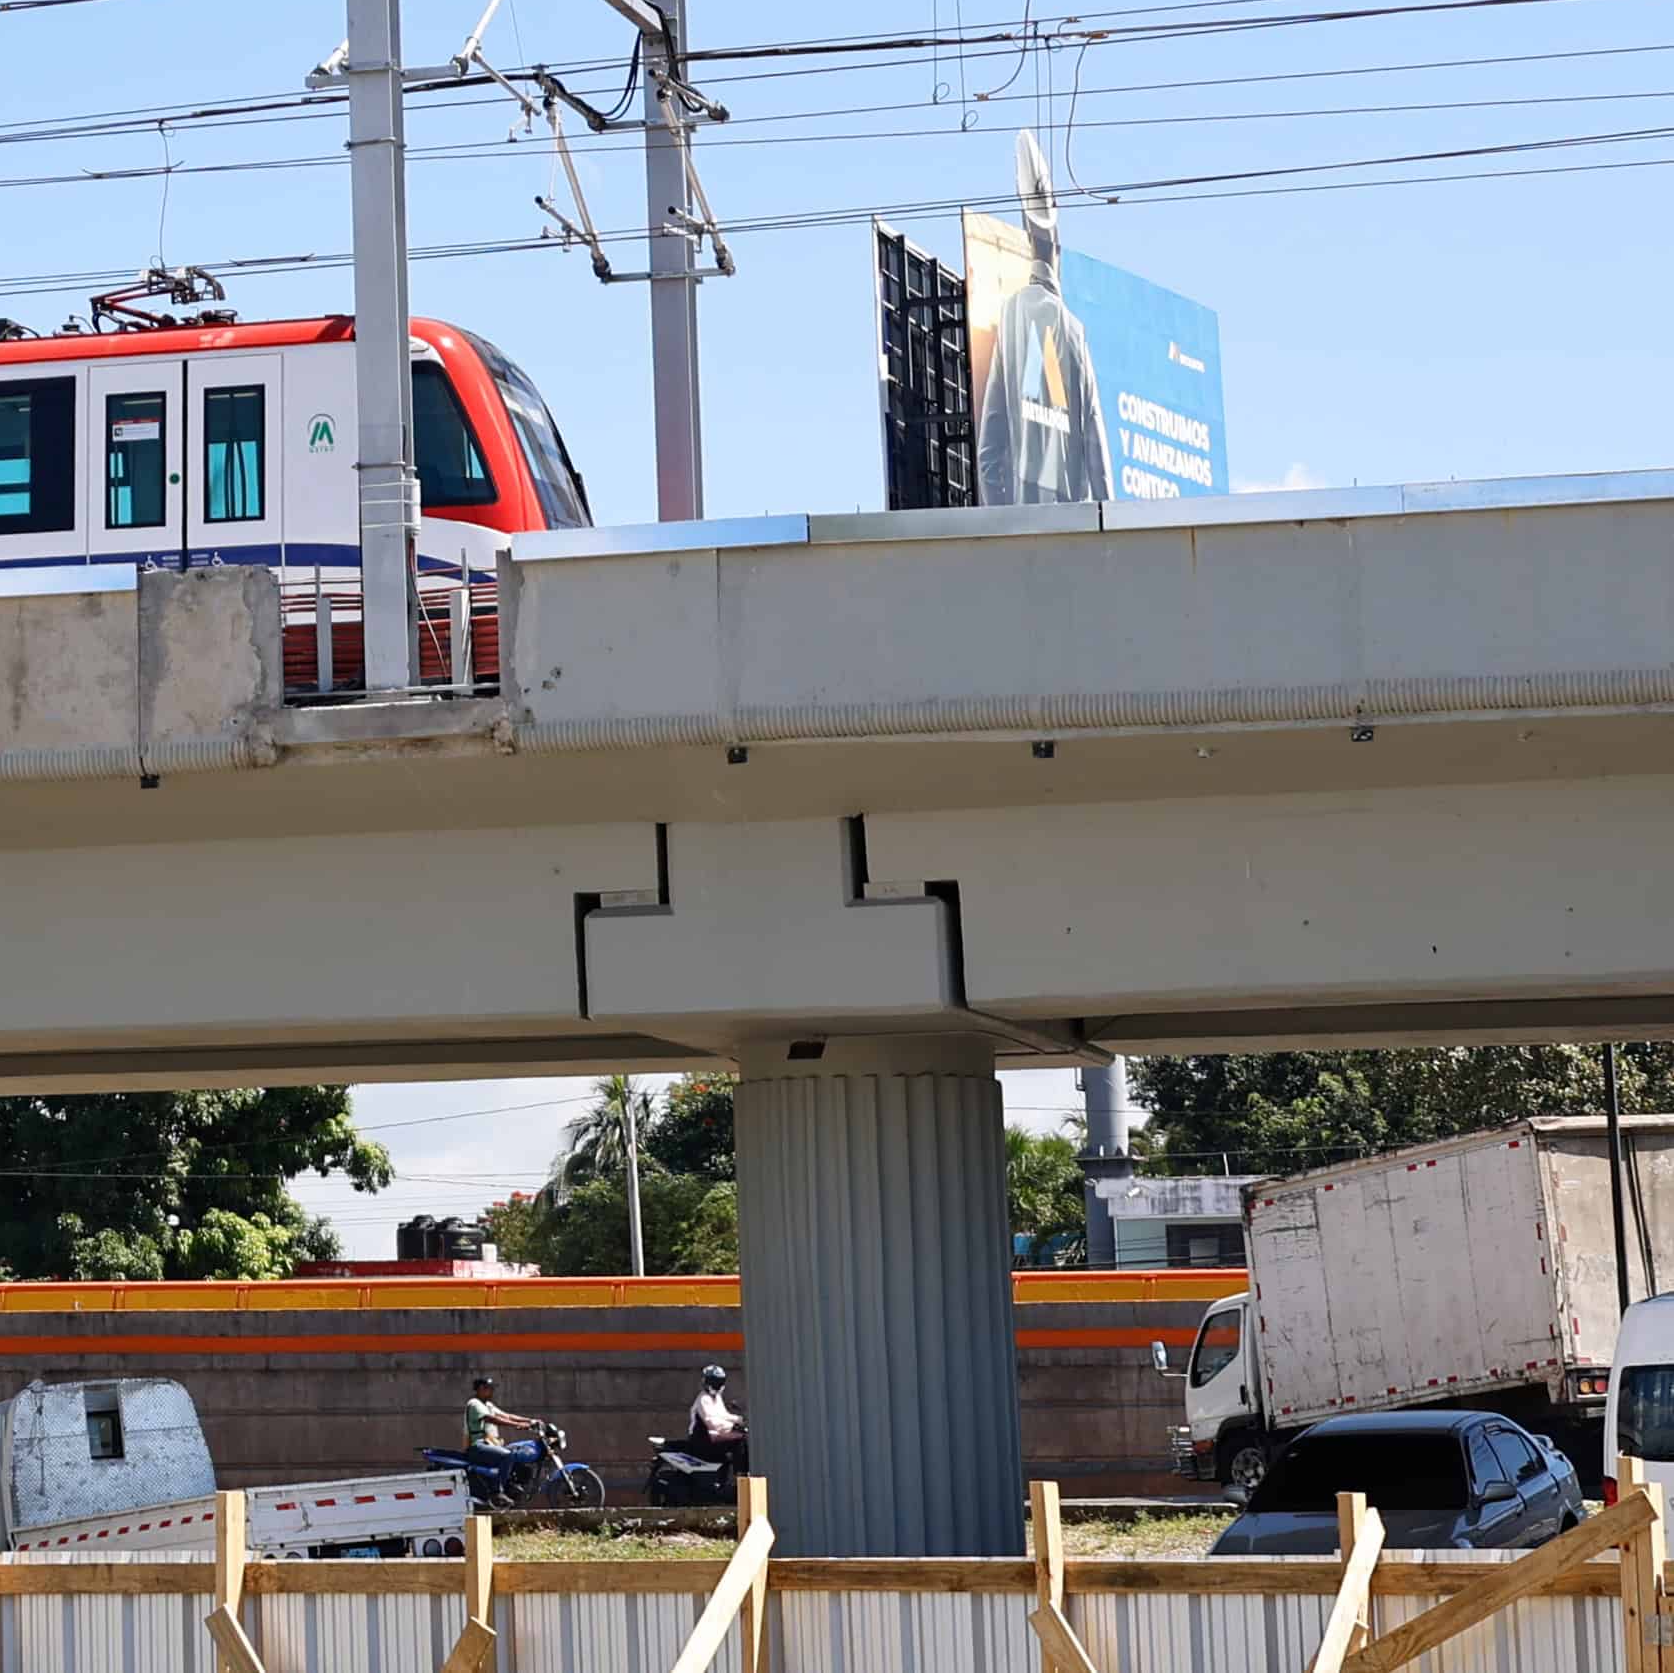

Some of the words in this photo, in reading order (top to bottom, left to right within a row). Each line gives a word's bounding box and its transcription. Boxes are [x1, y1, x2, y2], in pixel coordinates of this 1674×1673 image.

[1118, 392, 1210, 452] CONSTRUIMOS
[1119, 428, 1130, 457] Y
[1133, 433, 1212, 487] AVANZAMOS
